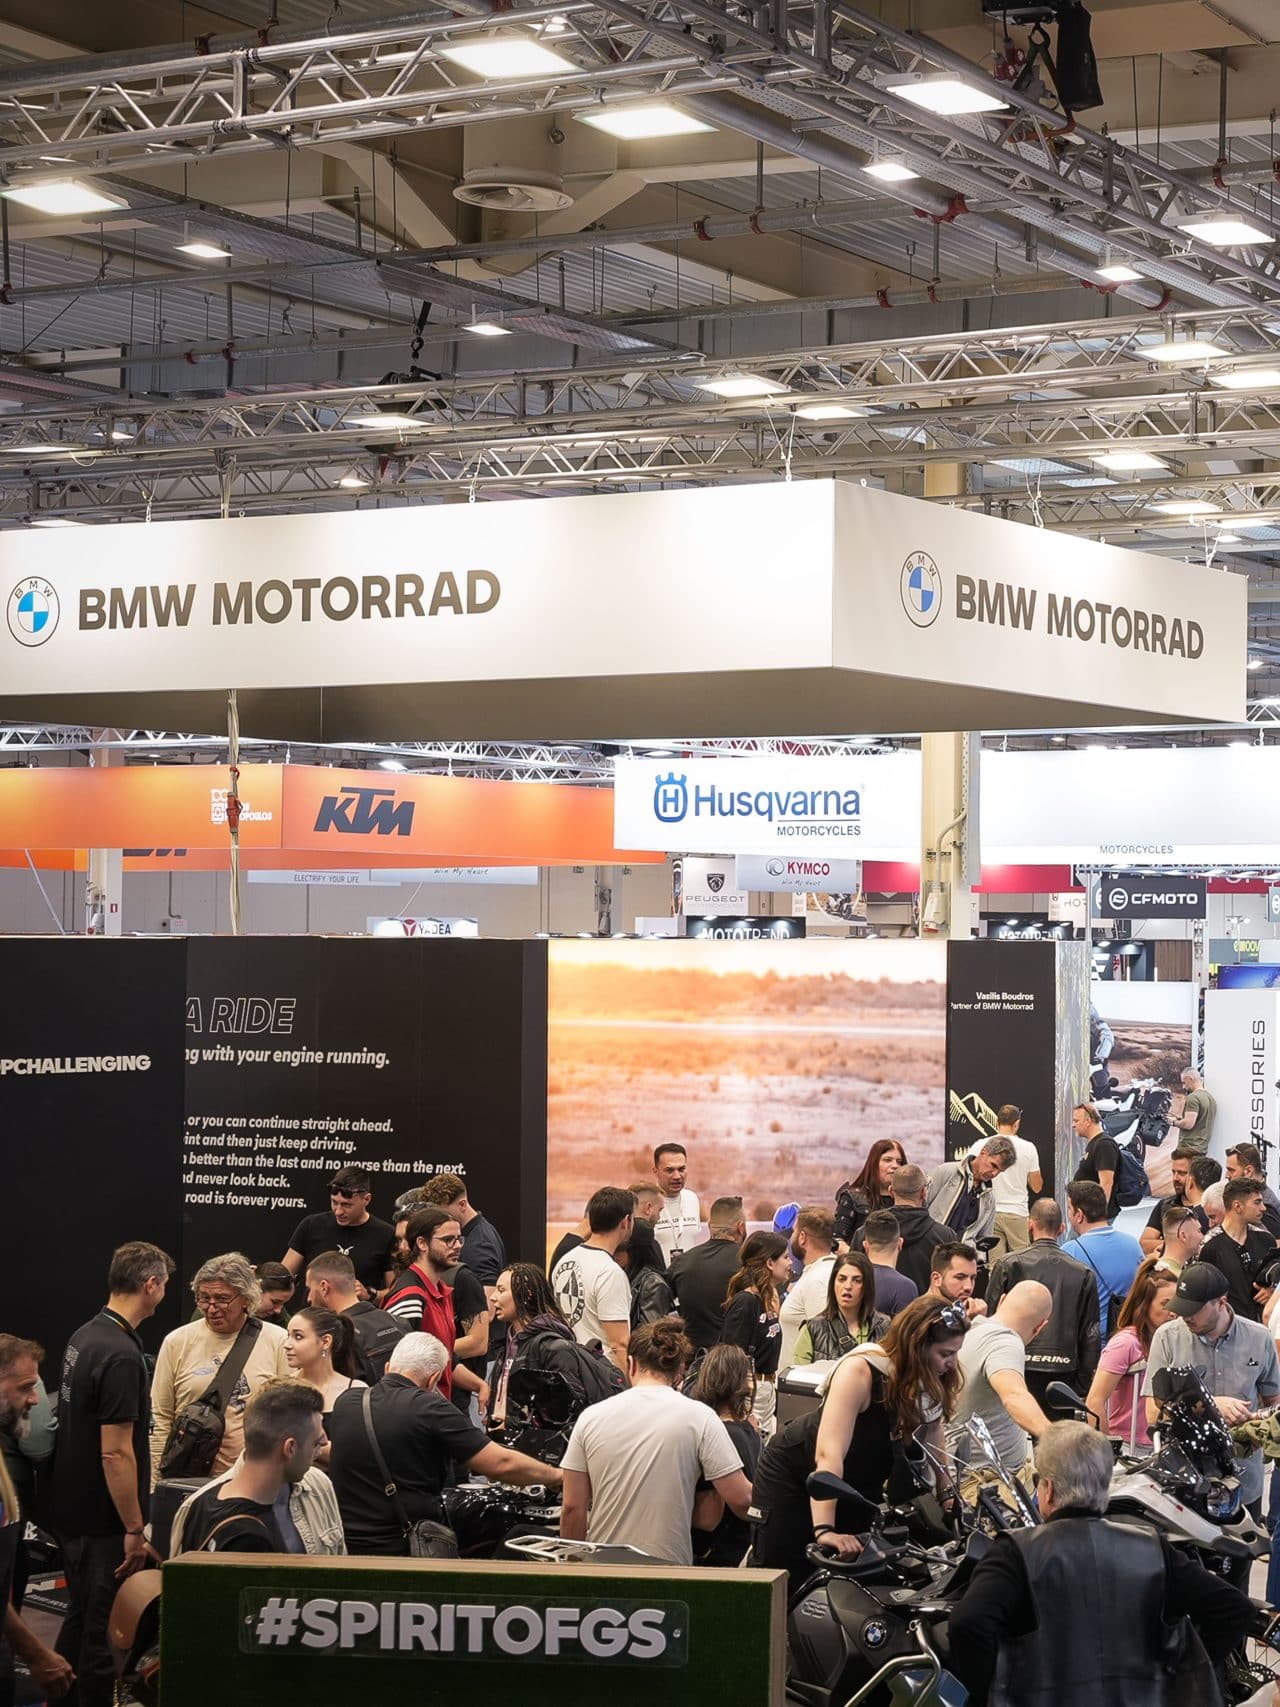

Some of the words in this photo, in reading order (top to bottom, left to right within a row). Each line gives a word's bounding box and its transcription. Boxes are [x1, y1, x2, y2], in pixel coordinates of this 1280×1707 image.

[78, 583, 196, 631] BMW
[212, 569, 501, 625] MOTORRAD
[956, 575, 1037, 631] BMW
[1047, 593, 1204, 660] MOTORRAD
[313, 787, 415, 836] KTM
[695, 785, 860, 822] Husqvarna
[777, 826, 861, 835] MOTORCYCLES
[1100, 845, 1173, 854] MOTORCYCLES
[787, 861, 830, 876] KYMCO
[294, 874, 326, 882] ELECTRIFY
[329, 875, 345, 883] YOUR
[686, 895, 745, 903] PEUGEOT
[1131, 893, 1198, 905] CFMOTO
[418, 924, 451, 935] YADEA
[976, 992, 1000, 1000] Vasilis
[1002, 992, 1034, 1000] Boudros
[186, 997, 202, 1032] A
[209, 998, 296, 1034] RIDE
[973, 1002, 981, 1010] of
[0, 1055, 151, 1075] PCHALLENGING
[202, 1044, 235, 1061] with
[237, 1049, 271, 1065] your
[273, 1045, 324, 1067] engine
[326, 1046, 390, 1068] running.
[187, 1117, 200, 1127] or
[202, 1117, 224, 1130] you
[225, 1117, 247, 1128] can
[248, 1114, 300, 1129] continue
[301, 1116, 351, 1134] straight
[351, 1118, 394, 1133] ahead.
[202, 1133, 225, 1146] and
[226, 1133, 253, 1148] then
[253, 1135, 277, 1151] just
[278, 1136, 308, 1153] keep
[310, 1137, 357, 1154] driving.
[189, 1152, 225, 1166] better
[226, 1154, 253, 1167] than
[255, 1155, 274, 1168] the
[276, 1155, 299, 1169] last
[300, 1157, 324, 1170] and
[325, 1160, 342, 1171] no
[382, 1159, 411, 1174] than
[412, 1161, 434, 1174] the
[434, 1163, 467, 1176] next.
[195, 1174, 228, 1186] never
[229, 1172, 256, 1187] look
[257, 1173, 291, 1188] back.
[185, 1191, 212, 1204] road
[214, 1192, 225, 1204] is
[226, 1192, 270, 1206] forever
[270, 1196, 308, 1210] yours.
[256, 1598, 667, 1659] #SPIRITOFGS
